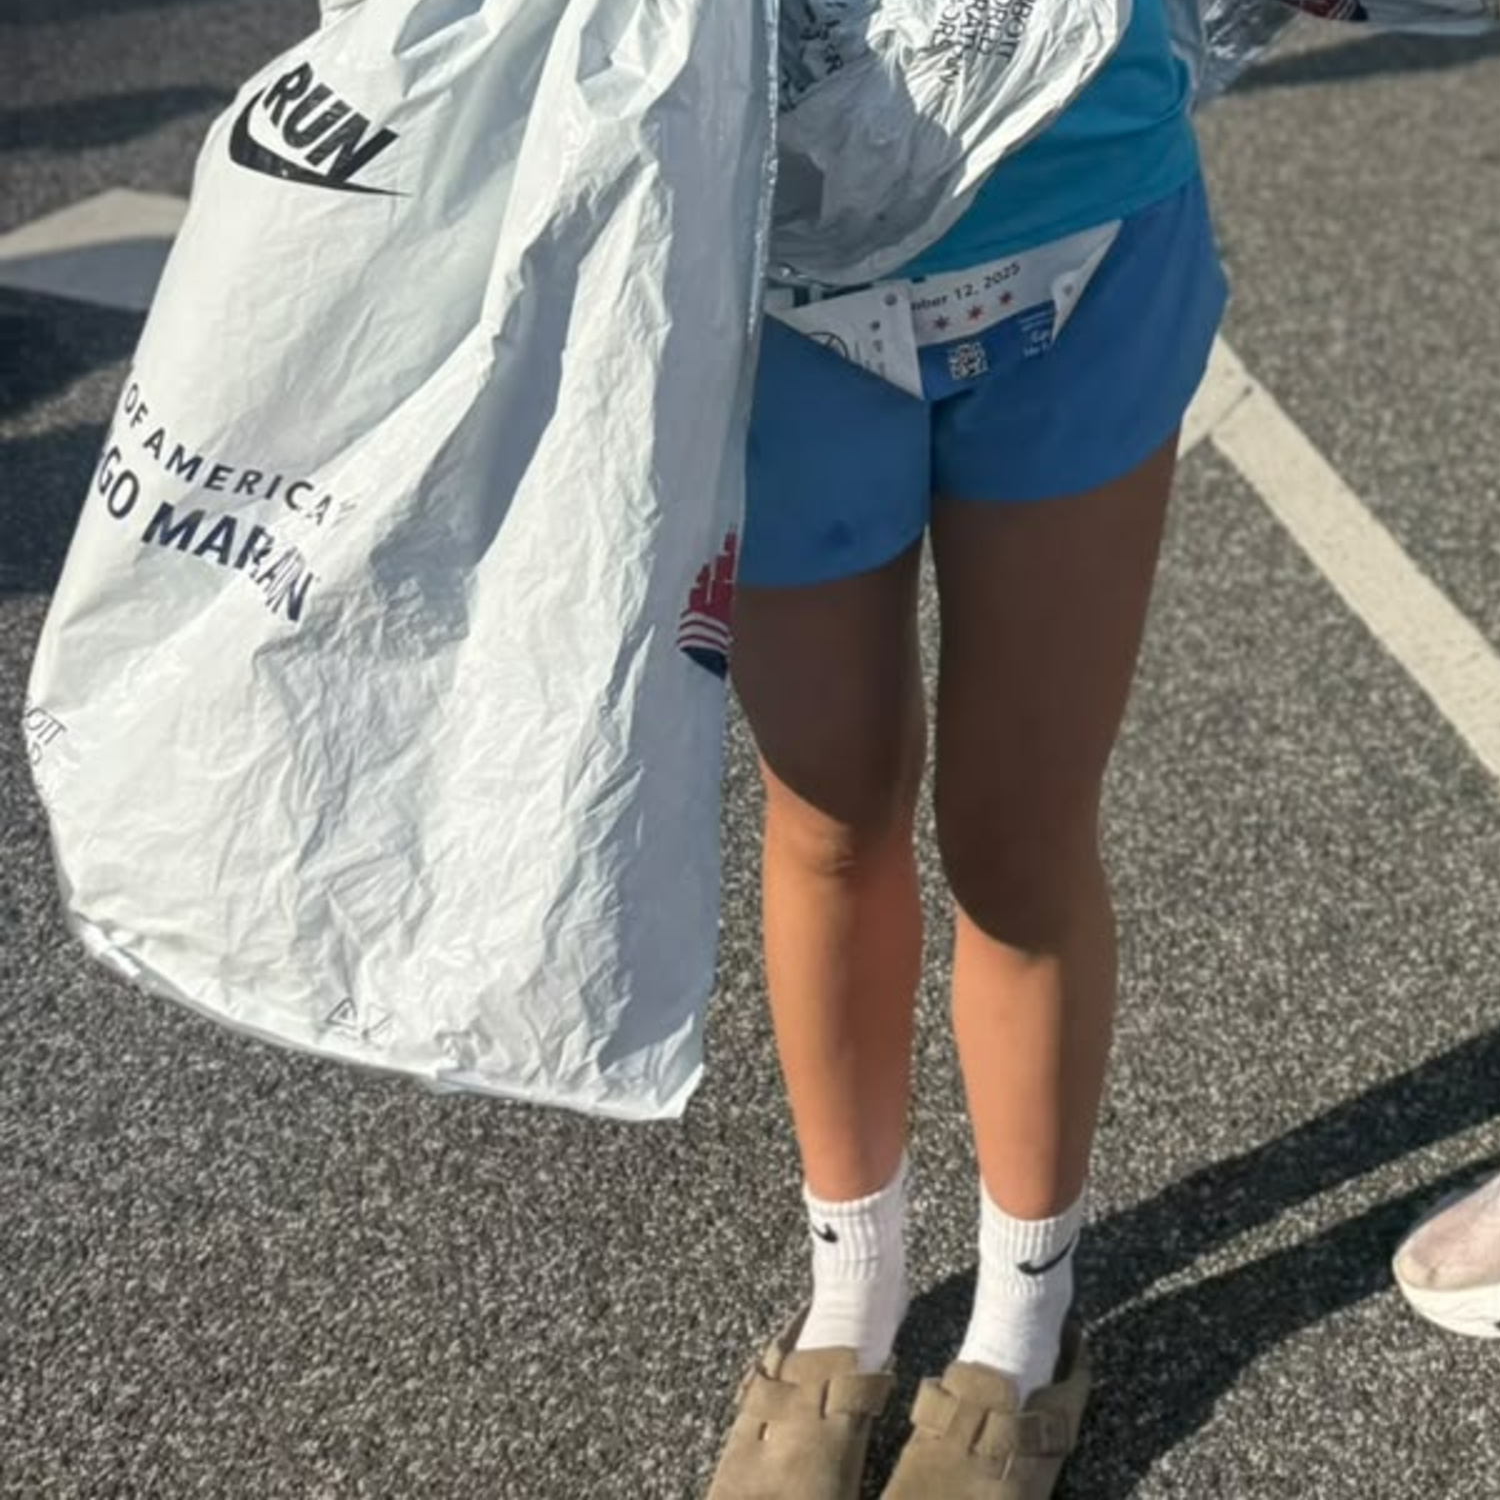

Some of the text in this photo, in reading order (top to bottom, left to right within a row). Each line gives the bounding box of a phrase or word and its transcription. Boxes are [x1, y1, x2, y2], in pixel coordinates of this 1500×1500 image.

[261, 60, 400, 183] RUN
[124, 382, 333, 527] OF AMERICA
